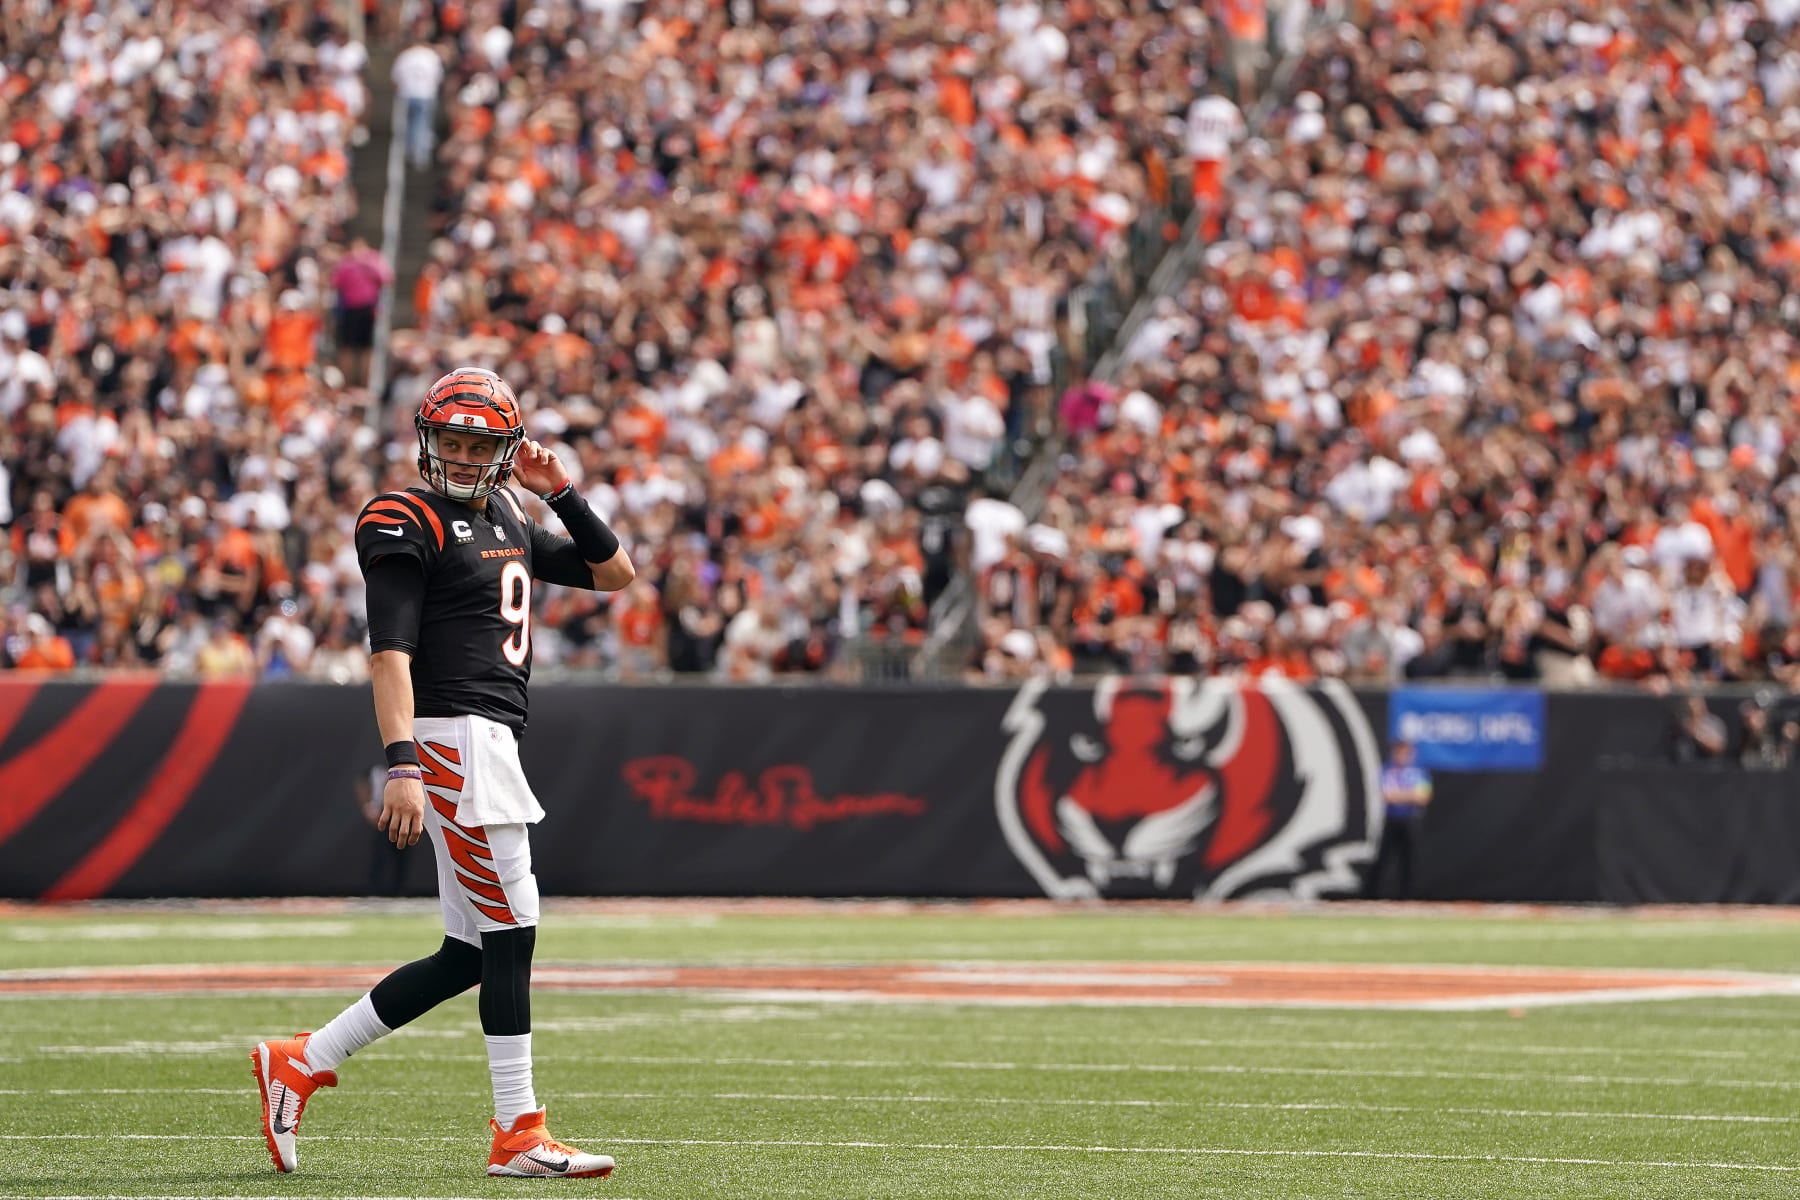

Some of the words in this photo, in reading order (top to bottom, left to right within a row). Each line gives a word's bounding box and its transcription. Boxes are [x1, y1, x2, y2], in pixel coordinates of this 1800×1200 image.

[452, 520, 473, 538] C
[480, 547, 525, 559] BENGALS
[500, 560, 532, 667] 9
